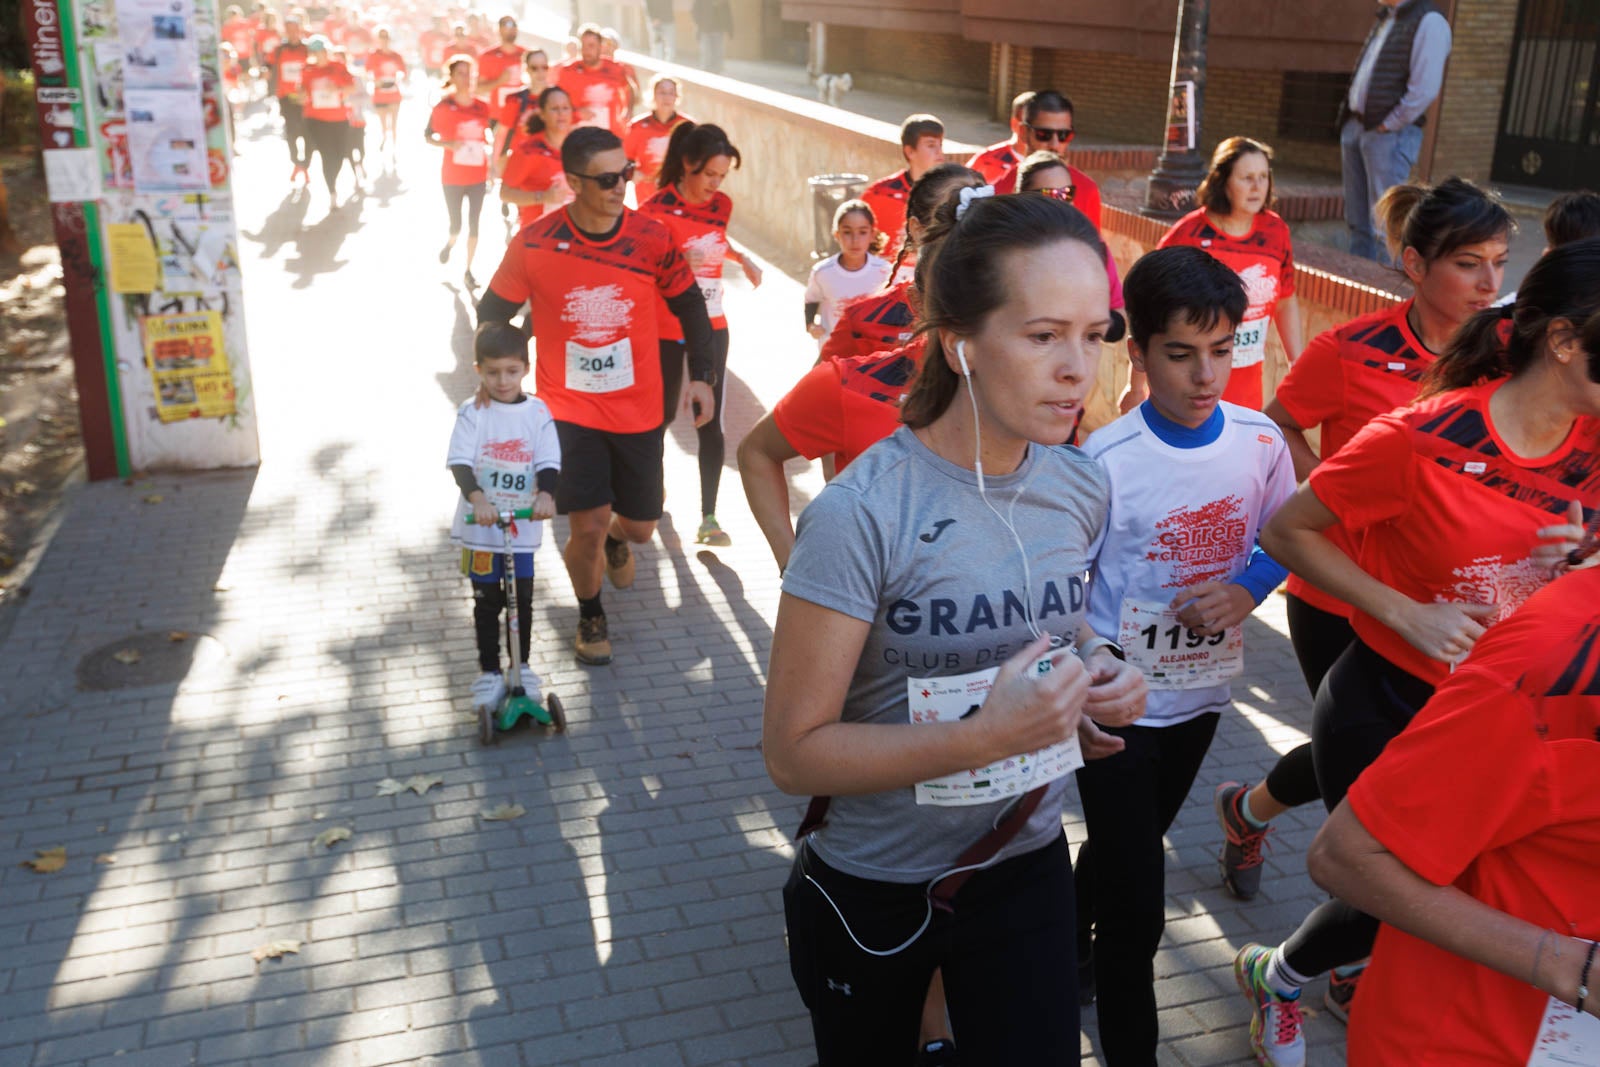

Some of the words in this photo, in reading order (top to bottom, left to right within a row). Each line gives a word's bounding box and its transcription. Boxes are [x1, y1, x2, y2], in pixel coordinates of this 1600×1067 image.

[33, 0, 59, 67] tiner
[579, 355, 616, 373] 204
[489, 471, 527, 492] 198
[1159, 522, 1247, 547] carrera
[883, 648, 961, 670] CLUB
[975, 643, 1009, 665] DE
[1159, 651, 1210, 664] ALEJANDRO
